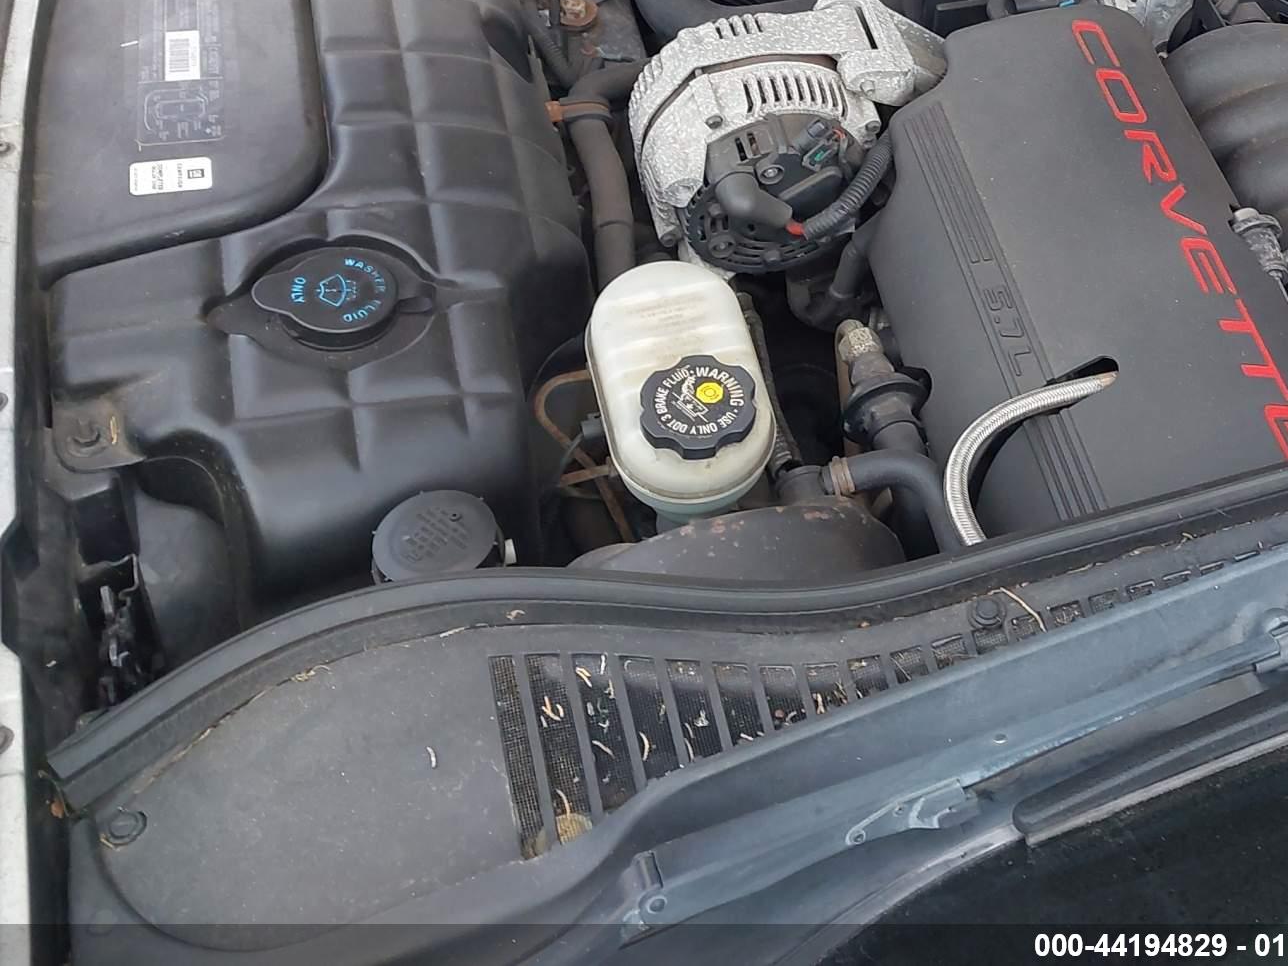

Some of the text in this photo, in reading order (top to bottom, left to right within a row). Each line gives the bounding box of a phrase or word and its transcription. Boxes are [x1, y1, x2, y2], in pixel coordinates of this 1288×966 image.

[290, 257, 386, 323] WASHER FLUID ONLY
[654, 366, 745, 435] WARNING USE ONLY DOT 3 BRAKE FLUID
